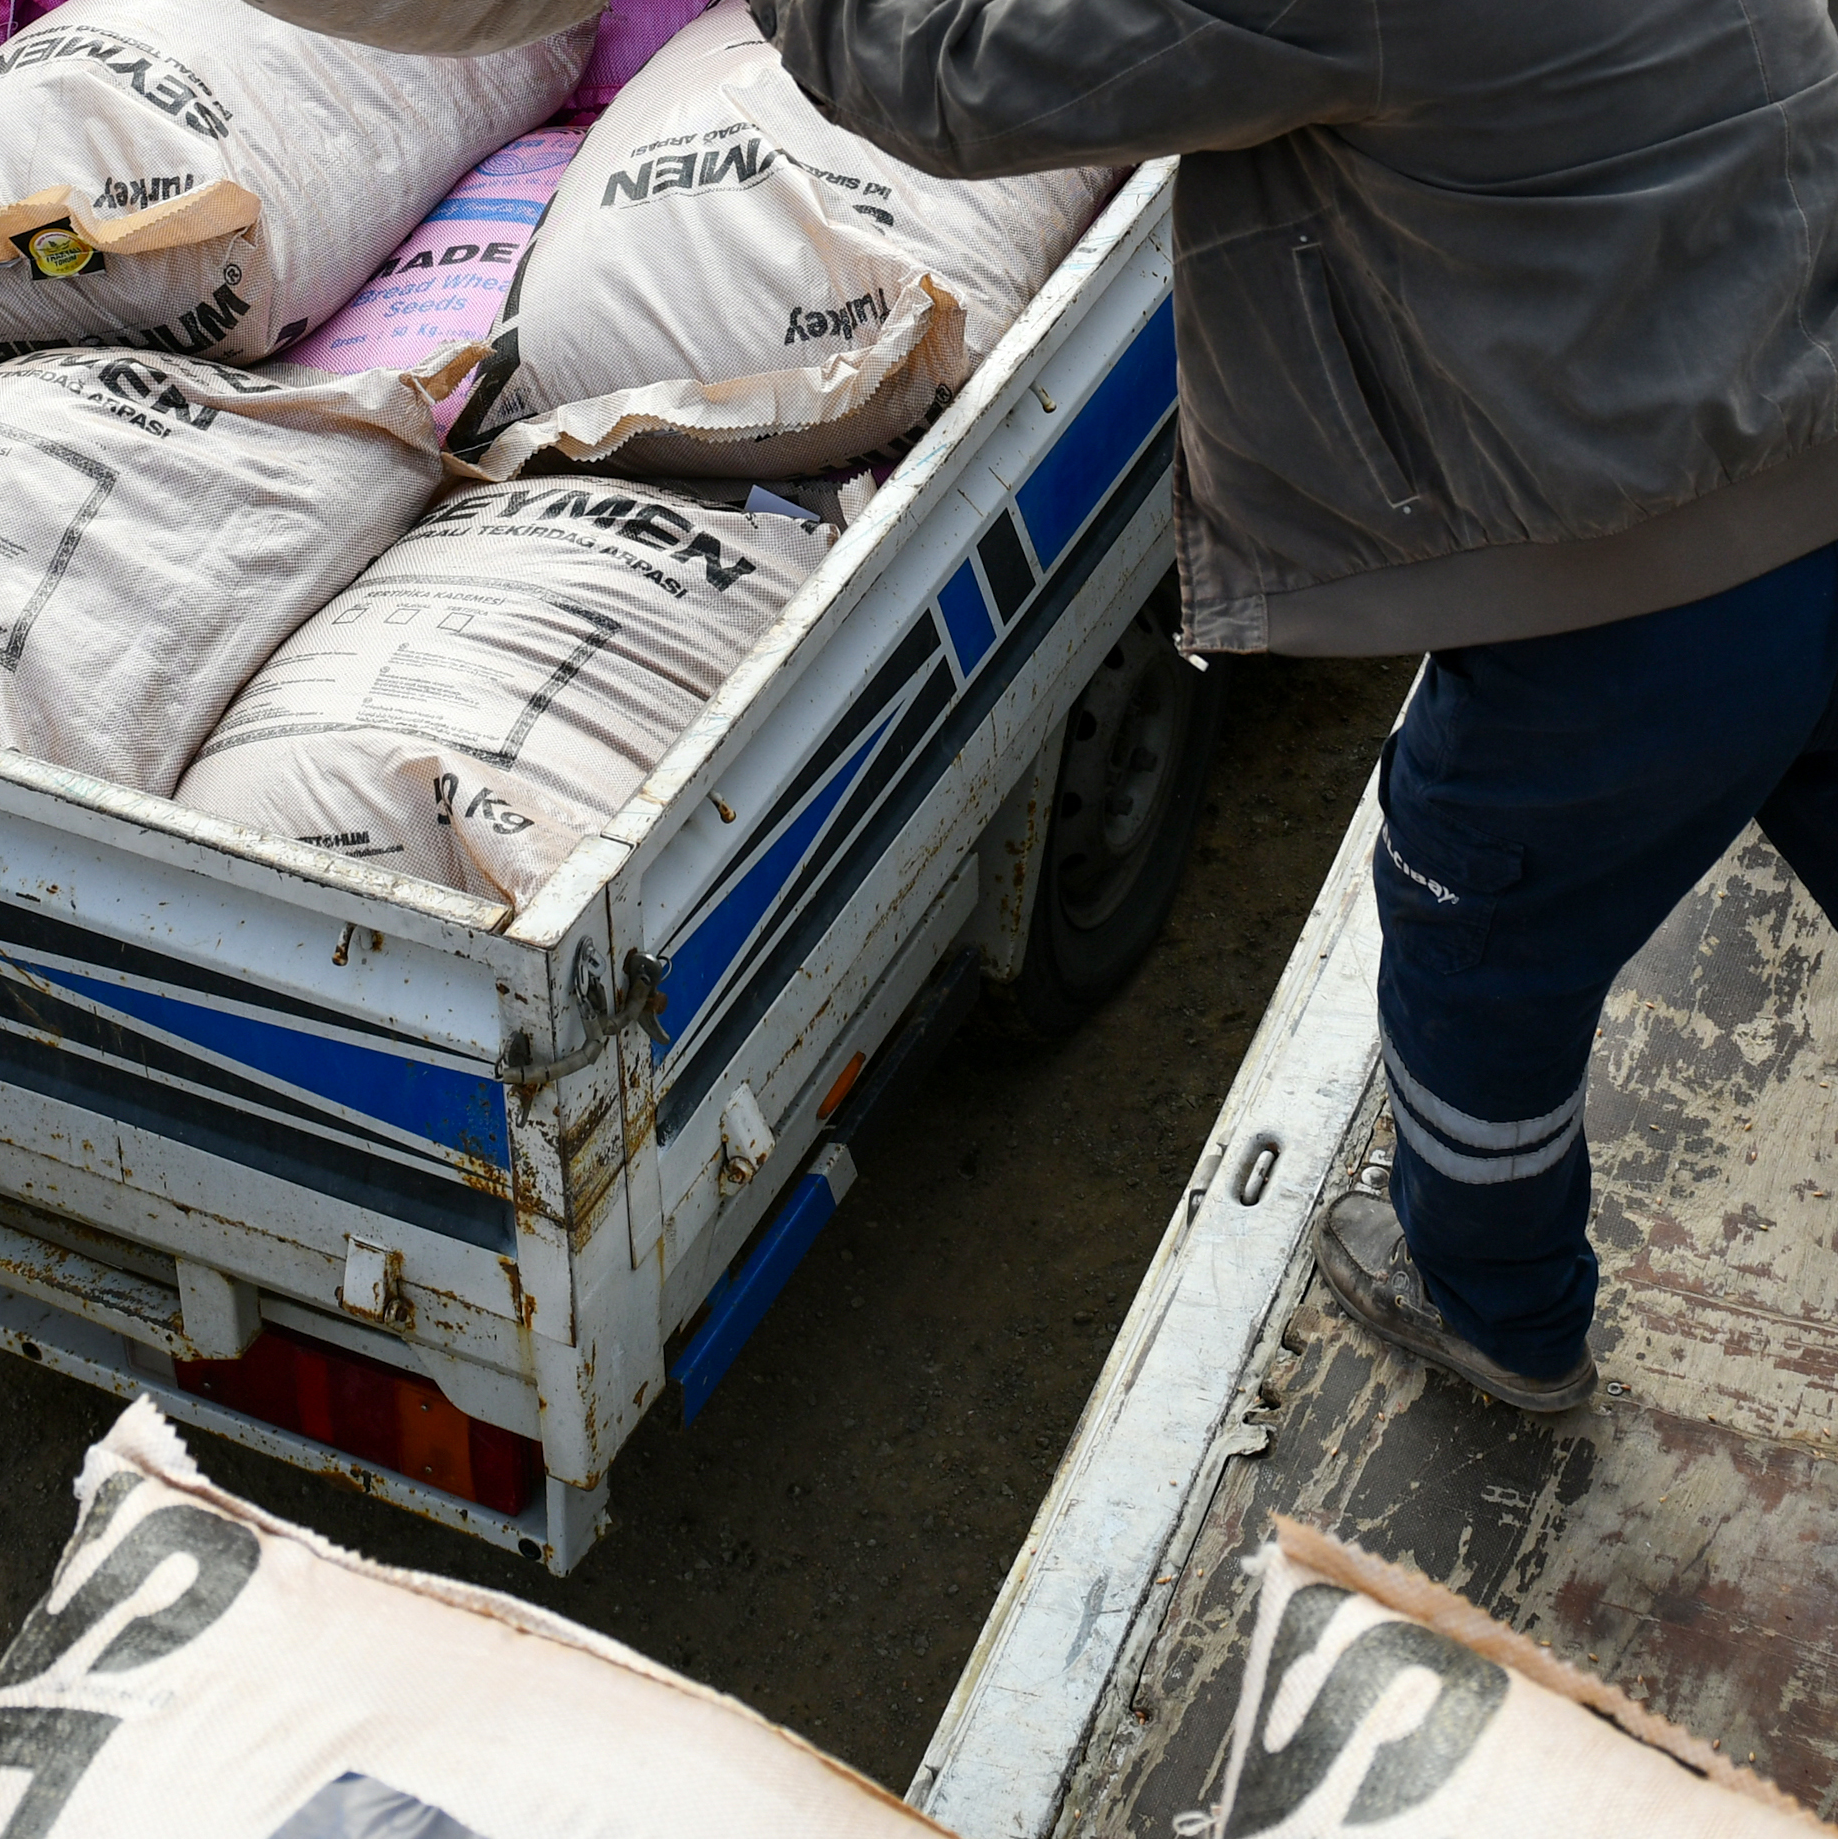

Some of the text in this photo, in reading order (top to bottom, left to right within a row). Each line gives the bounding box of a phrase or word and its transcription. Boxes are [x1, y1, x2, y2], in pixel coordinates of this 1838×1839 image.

[630, 132, 698, 158] ARPASI
[383, 294, 469, 319] Seeds
[421, 488, 757, 593] EYMEN
[477, 522, 687, 600] TEKİRDAĞ ARPASI
[432, 591, 507, 608] KADEMESİ
[464, 786, 536, 837] Kg
